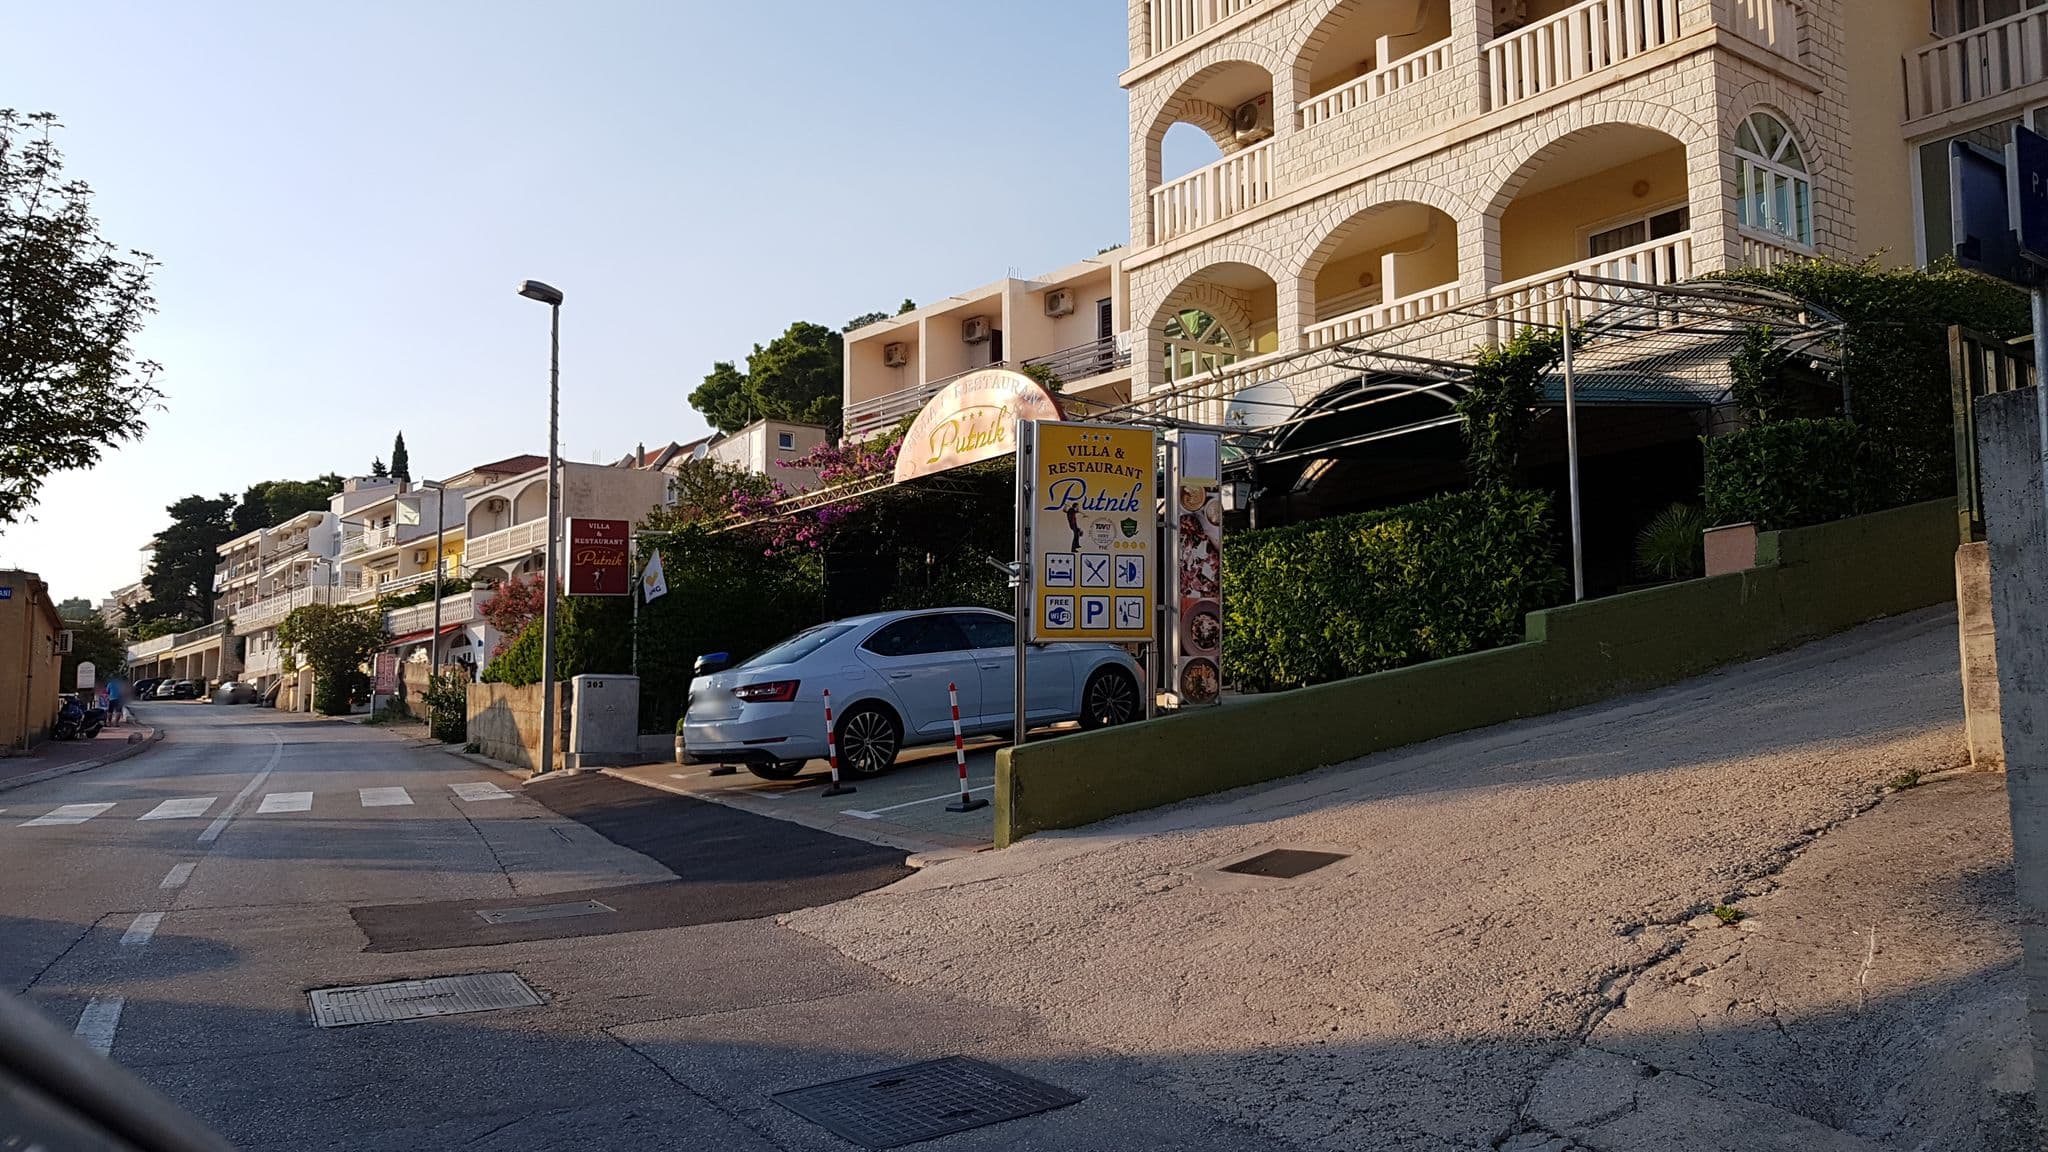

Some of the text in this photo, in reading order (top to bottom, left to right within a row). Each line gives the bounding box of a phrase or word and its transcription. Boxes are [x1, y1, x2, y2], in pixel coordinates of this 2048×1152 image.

[926, 405, 1008, 465] Putnik
[1067, 445, 1125, 459] VILLA &
[1048, 461, 1143, 480] RESTAURANT
[1043, 477, 1142, 512] Putnik
[588, 522, 610, 530] VILLA
[574, 537, 624, 546] RESTAURANT
[575, 549, 625, 566] Putnik
[1049, 598, 1069, 606] FREE
[1087, 600, 1104, 625] P
